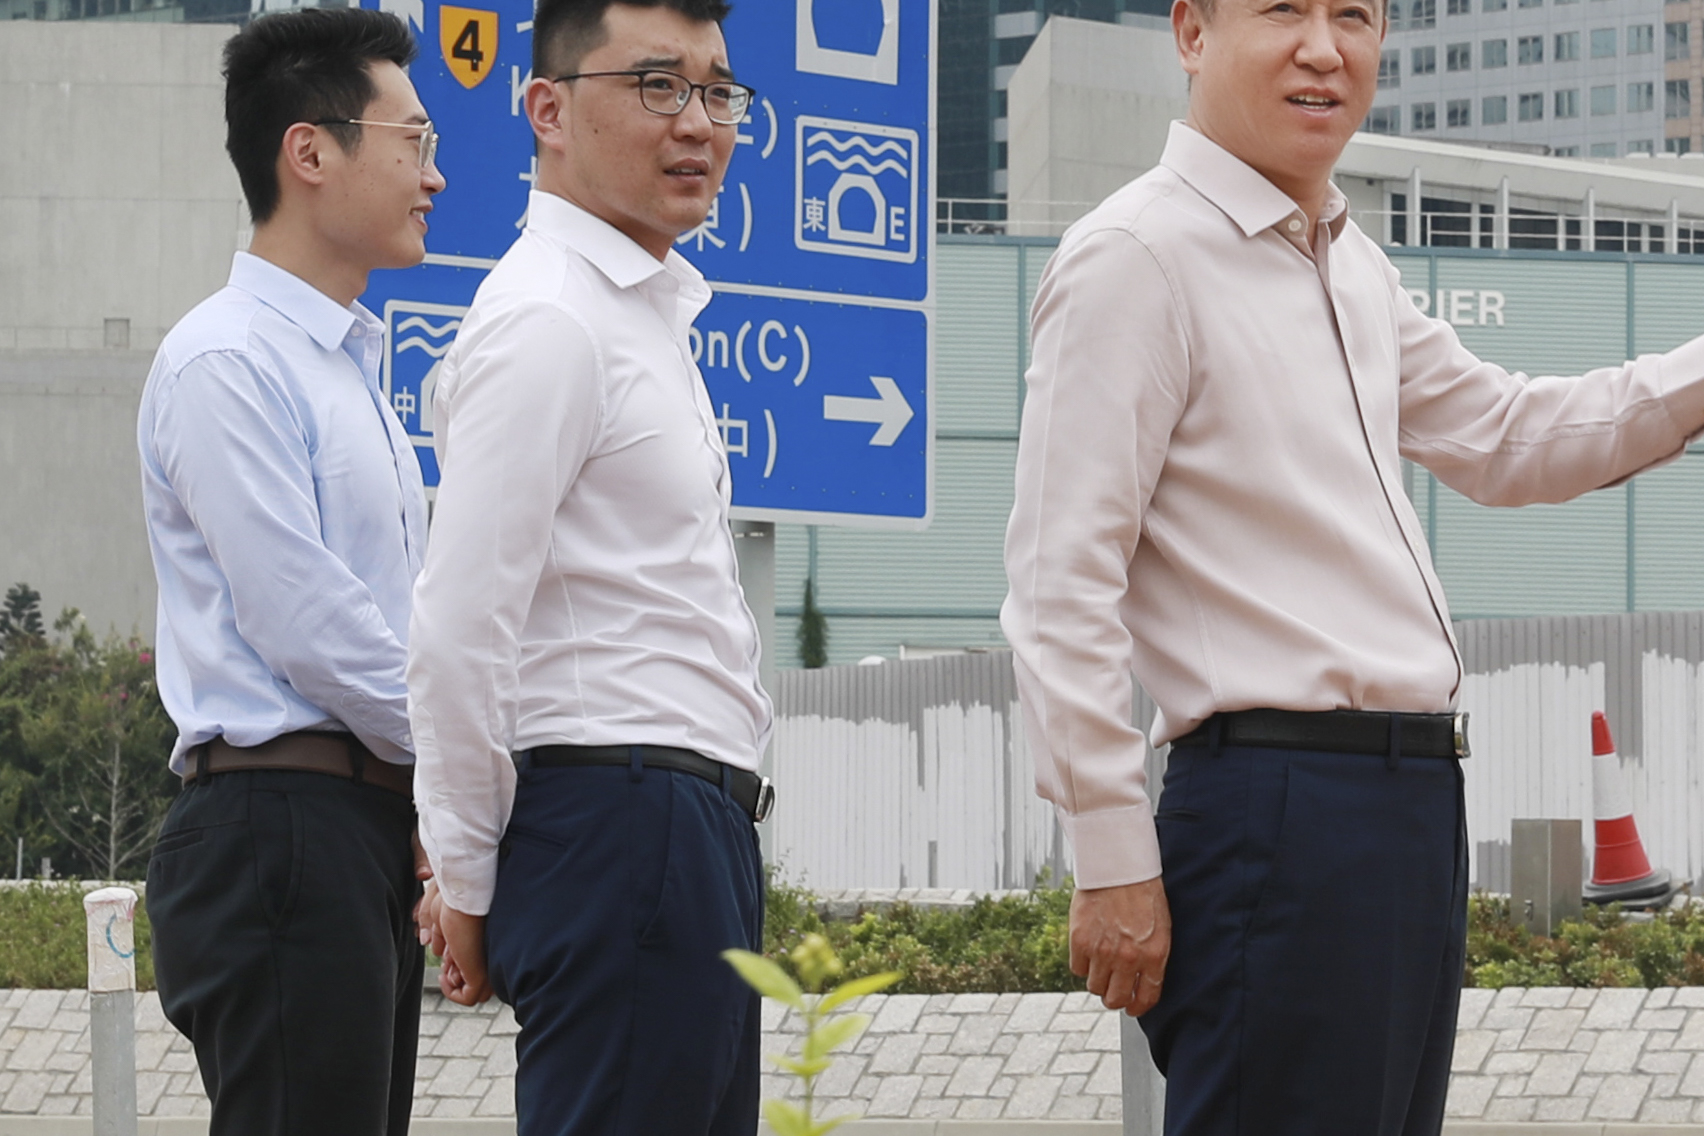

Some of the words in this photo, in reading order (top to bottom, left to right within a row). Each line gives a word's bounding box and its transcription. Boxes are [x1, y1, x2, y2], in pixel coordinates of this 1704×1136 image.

[451, 18, 484, 72] 4
[803, 196, 827, 233] 東
[890, 205, 905, 241] E
[394, 385, 416, 425] 中
